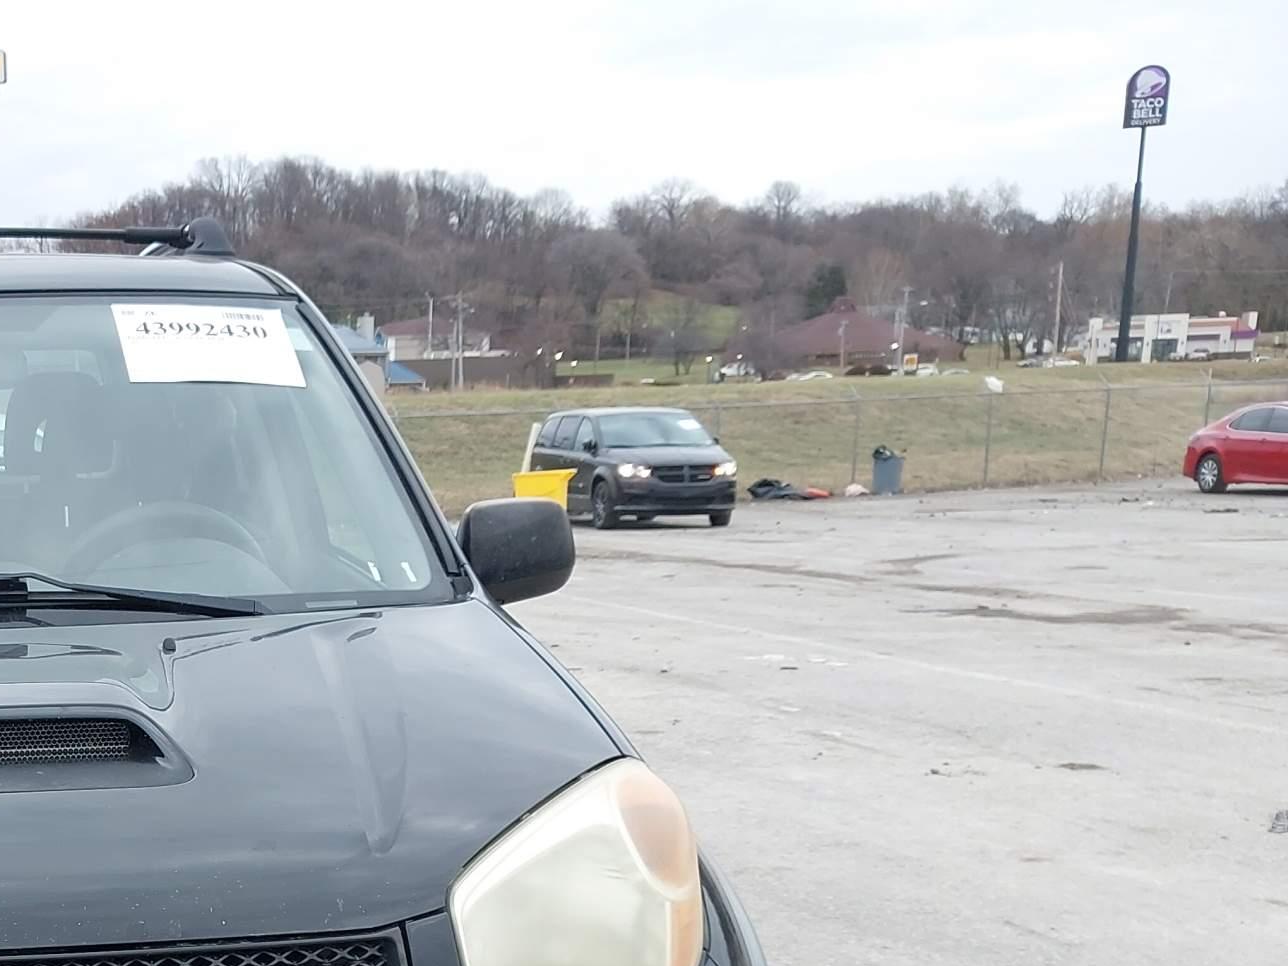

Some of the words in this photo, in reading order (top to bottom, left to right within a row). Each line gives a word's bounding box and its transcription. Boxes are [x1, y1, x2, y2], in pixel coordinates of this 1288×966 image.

[1131, 97, 1165, 109] TACO
[1132, 108, 1163, 119] BELL
[1130, 118, 1161, 126] DELIVERY
[135, 321, 269, 340] 43992430
